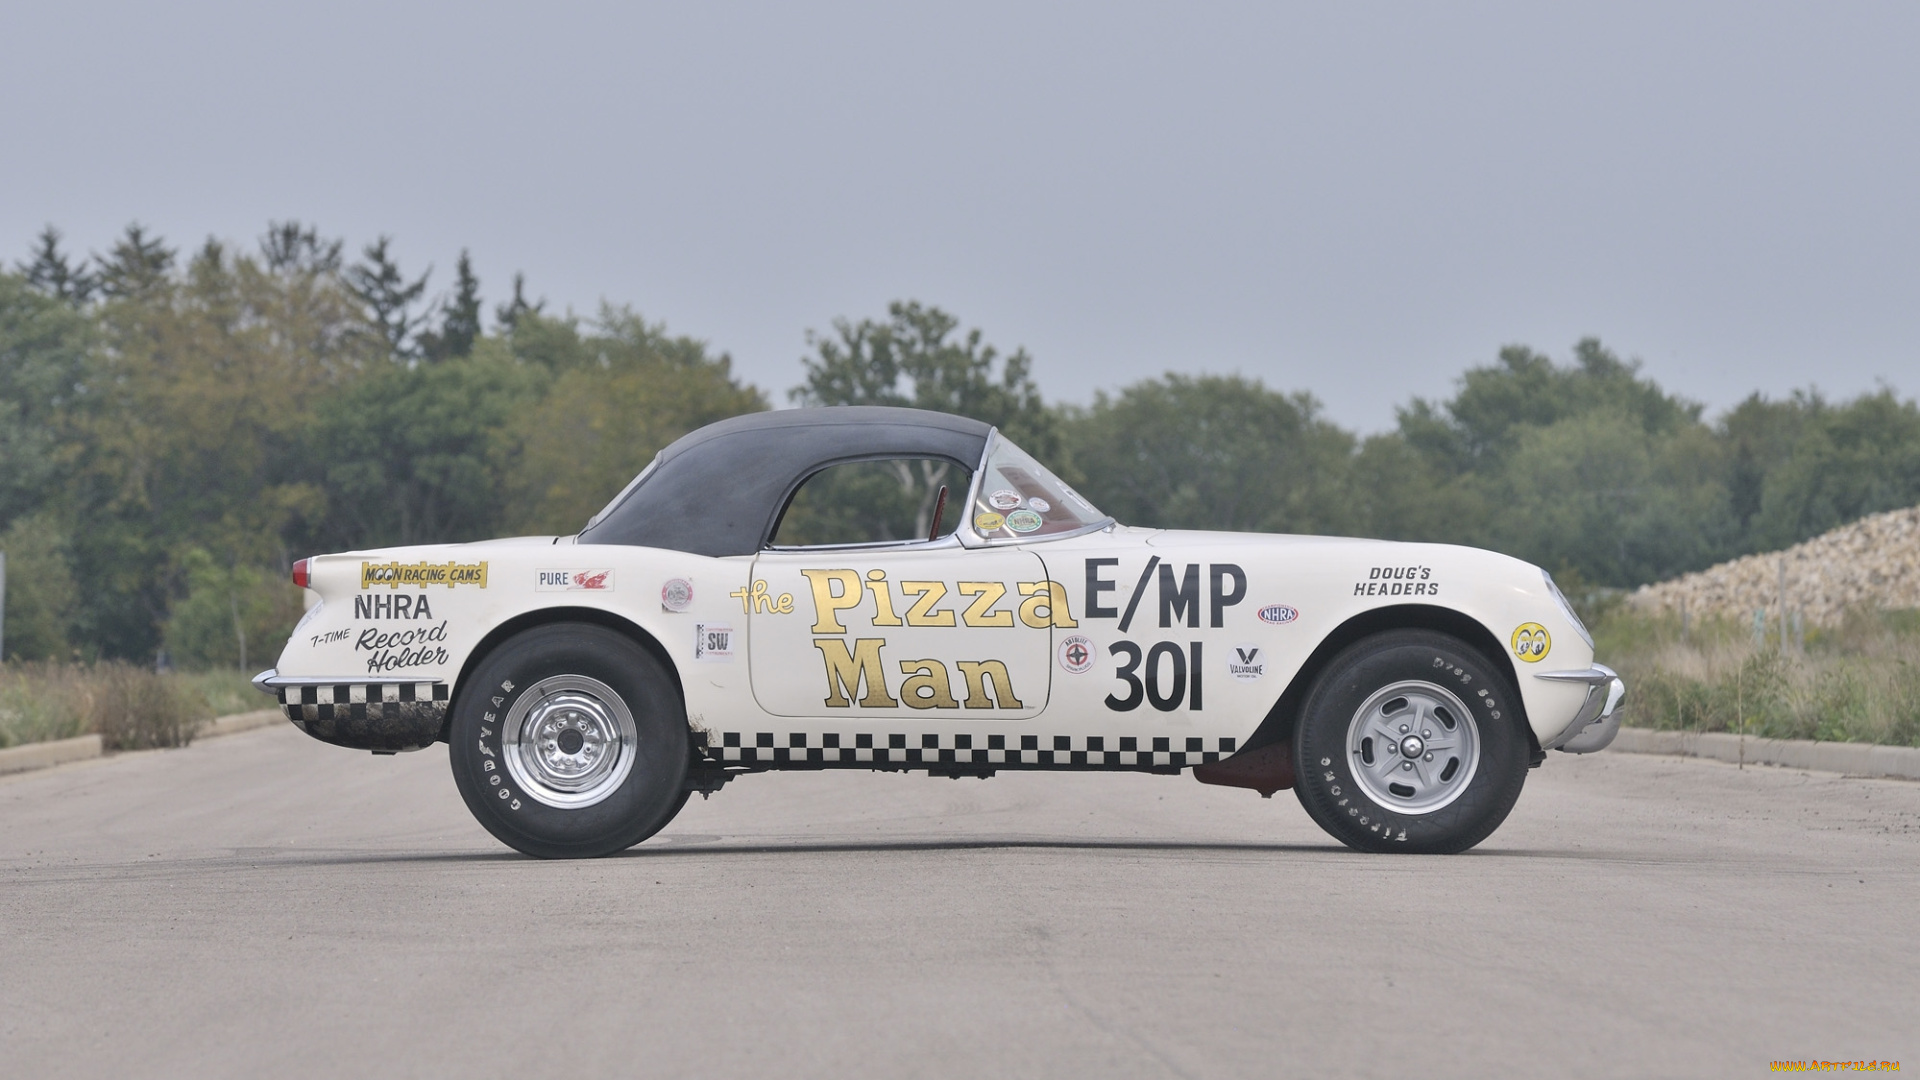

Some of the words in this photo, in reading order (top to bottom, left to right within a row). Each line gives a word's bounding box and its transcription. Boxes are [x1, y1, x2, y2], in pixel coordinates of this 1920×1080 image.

[364, 567, 403, 581] MOON
[403, 569, 447, 581] RACING
[449, 569, 482, 581] CAMS
[539, 572, 569, 586] PURE
[1369, 565, 1431, 580] DOUG'S
[730, 579, 794, 615] the
[1085, 555, 1247, 634] E/MP
[1353, 582, 1439, 596] HEADERS
[354, 594, 433, 620] NHRA
[800, 568, 1079, 635] Pizza
[1264, 608, 1293, 621] NHRA
[310, 628, 351, 648] 7-TIME
[355, 619, 448, 651] Record
[707, 632, 729, 651] SW
[1065, 637, 1087, 647] AUTOLITE
[367, 645, 449, 673] Holder
[1229, 663, 1263, 676] VALVOLINE
[813, 637, 1024, 710] Man
[1104, 640, 1203, 712] 301
[478, 679, 522, 811] GOODYEAR
